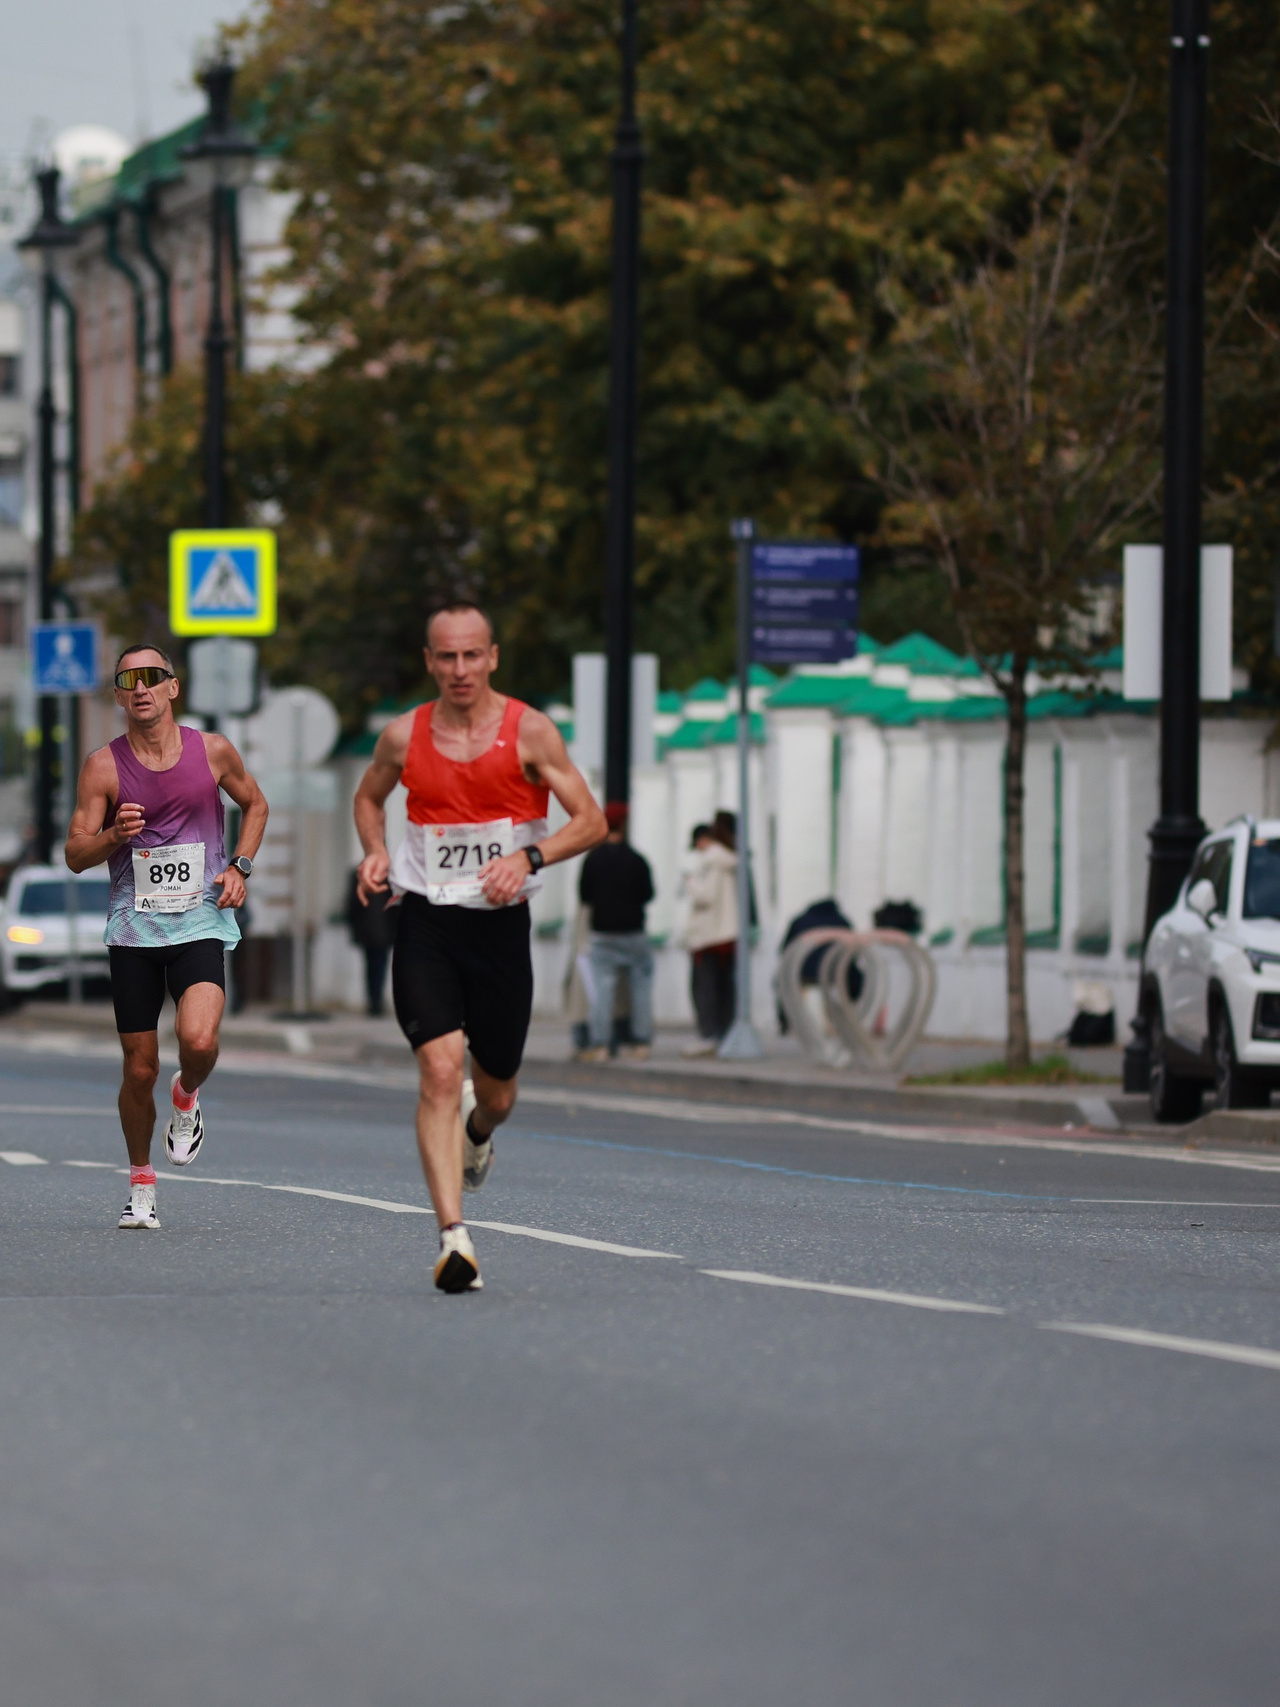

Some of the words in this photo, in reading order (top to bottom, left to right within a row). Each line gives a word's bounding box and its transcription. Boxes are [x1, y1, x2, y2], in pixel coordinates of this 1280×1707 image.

[438, 843, 501, 868] 2718
[149, 862, 190, 884] 898
[141, 898, 151, 909] A
